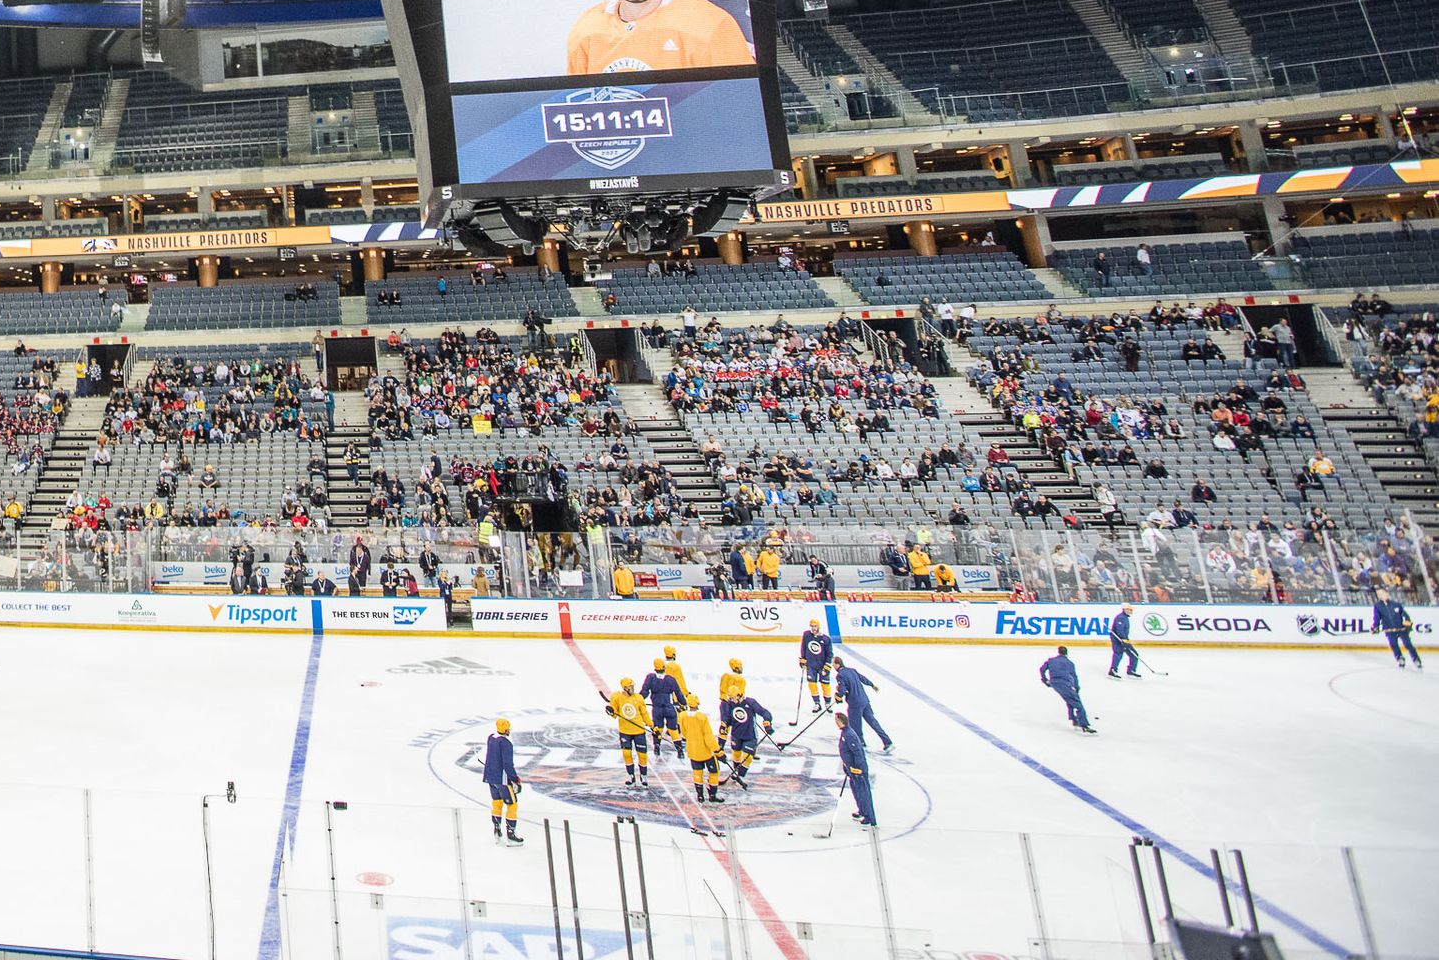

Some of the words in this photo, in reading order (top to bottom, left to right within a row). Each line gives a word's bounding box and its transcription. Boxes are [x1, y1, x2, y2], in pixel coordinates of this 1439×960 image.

[553, 108, 664, 132] 15:11:14
[603, 139, 638, 147] REPUBLIC
[764, 203, 841, 219] NASHVILLE
[852, 198, 934, 214] PREDATORS
[128, 235, 191, 249] NASHVILLE
[200, 231, 268, 246] PREDATORS
[162, 564, 184, 574] beko
[204, 565, 227, 574] beko
[656, 567, 682, 577] beko
[858, 568, 885, 578] beko
[962, 568, 990, 578] beko
[1, 603, 32, 611] COLLECT
[51, 604, 72, 612] BEST
[227, 604, 298, 624] Tipsport
[332, 610, 348, 619] THE
[349, 610, 370, 619] BEST
[372, 610, 389, 619] RUN
[393, 608, 421, 622] SAP
[472, 611, 505, 620] OBAL
[612, 614, 659, 622] REPUBLIC
[740, 606, 780, 621] aws
[995, 609, 1113, 635] FASTENAL
[1176, 614, 1272, 632] ŠKODA
[385, 666, 517, 677] adidas
